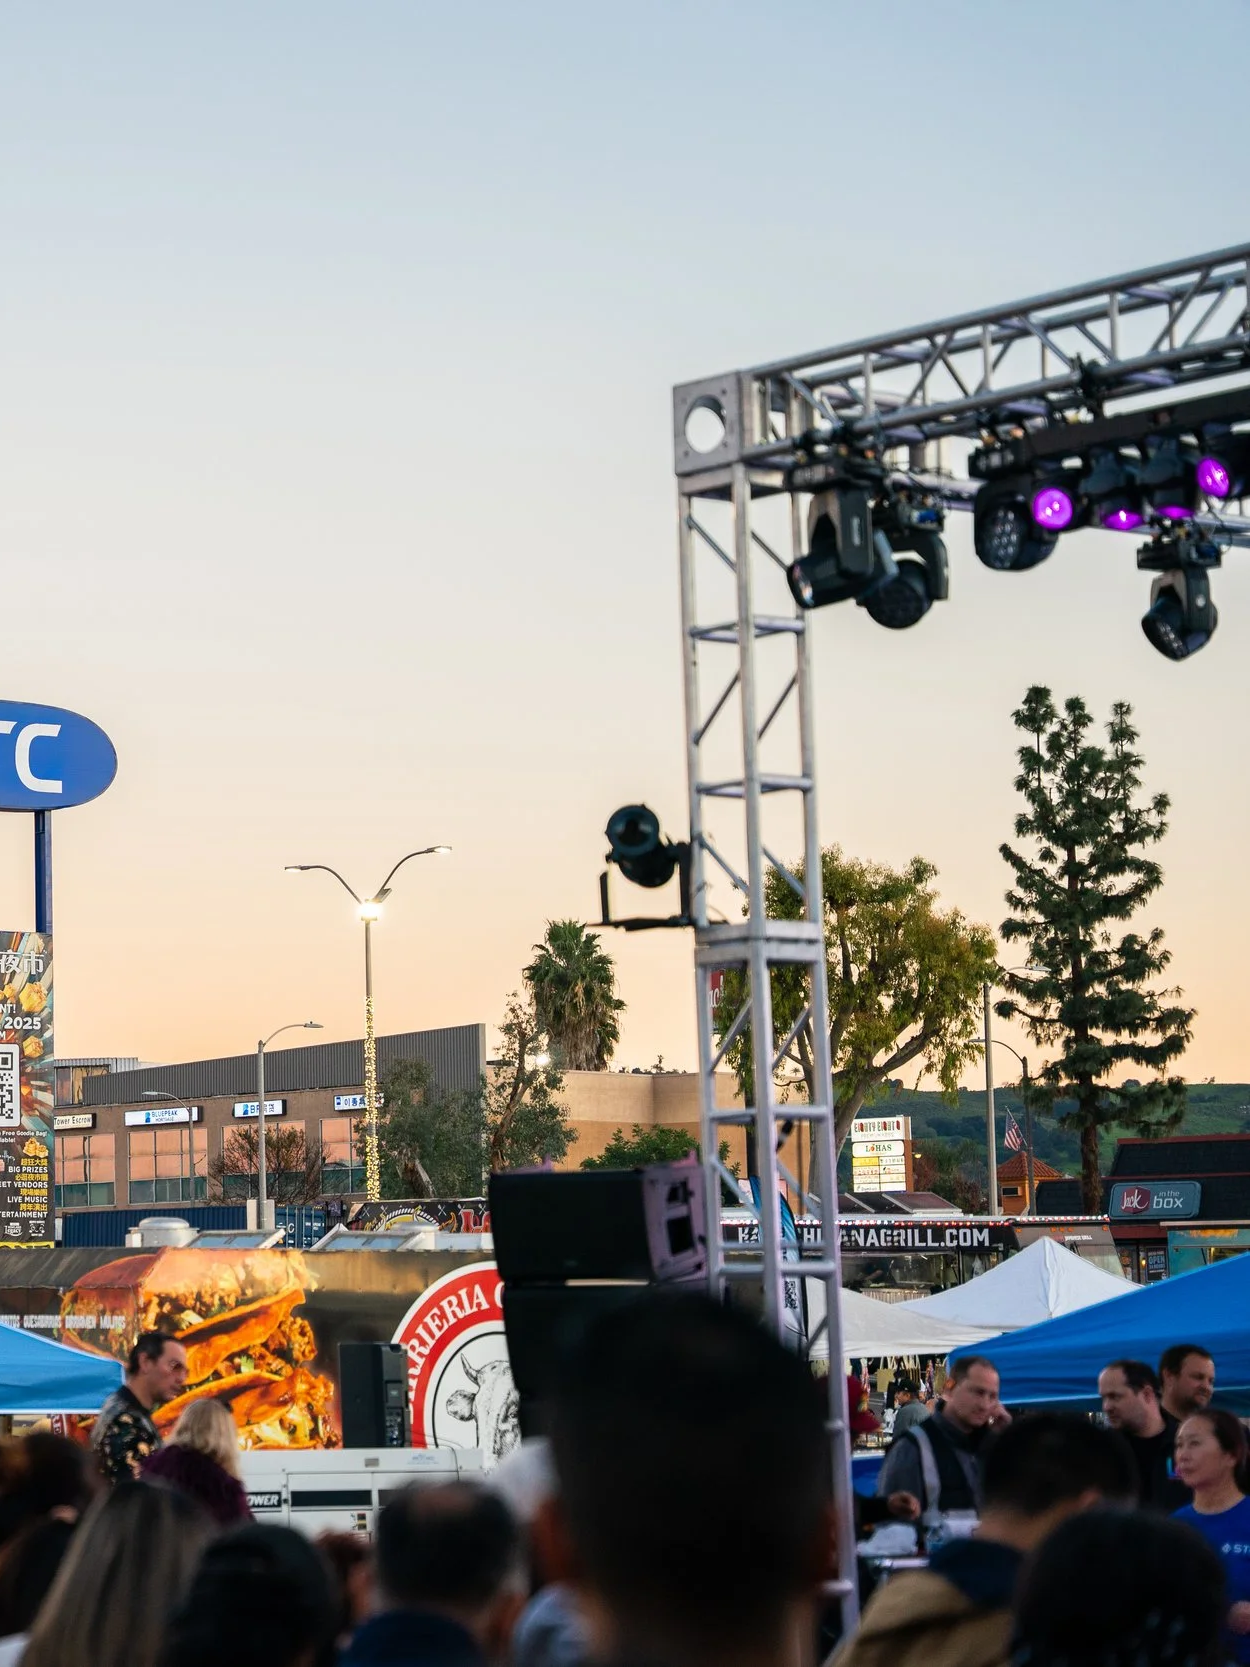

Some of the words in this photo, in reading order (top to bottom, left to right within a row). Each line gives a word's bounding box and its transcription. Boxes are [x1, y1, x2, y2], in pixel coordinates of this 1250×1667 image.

[4, 1016, 42, 1030] 2025
[151, 1109, 178, 1118] BLUEPEAK
[54, 1116, 71, 1126] Tower
[71, 1115, 92, 1125] Escrow
[21, 1166, 48, 1174] PRIZES
[13, 1181, 49, 1189] VENDORS
[1121, 1189, 1149, 1210] Jack
[1152, 1196, 1184, 1209] box
[1148, 1255, 1166, 1265] OPEN
[1233, 1544, 1250, 1554] ST
